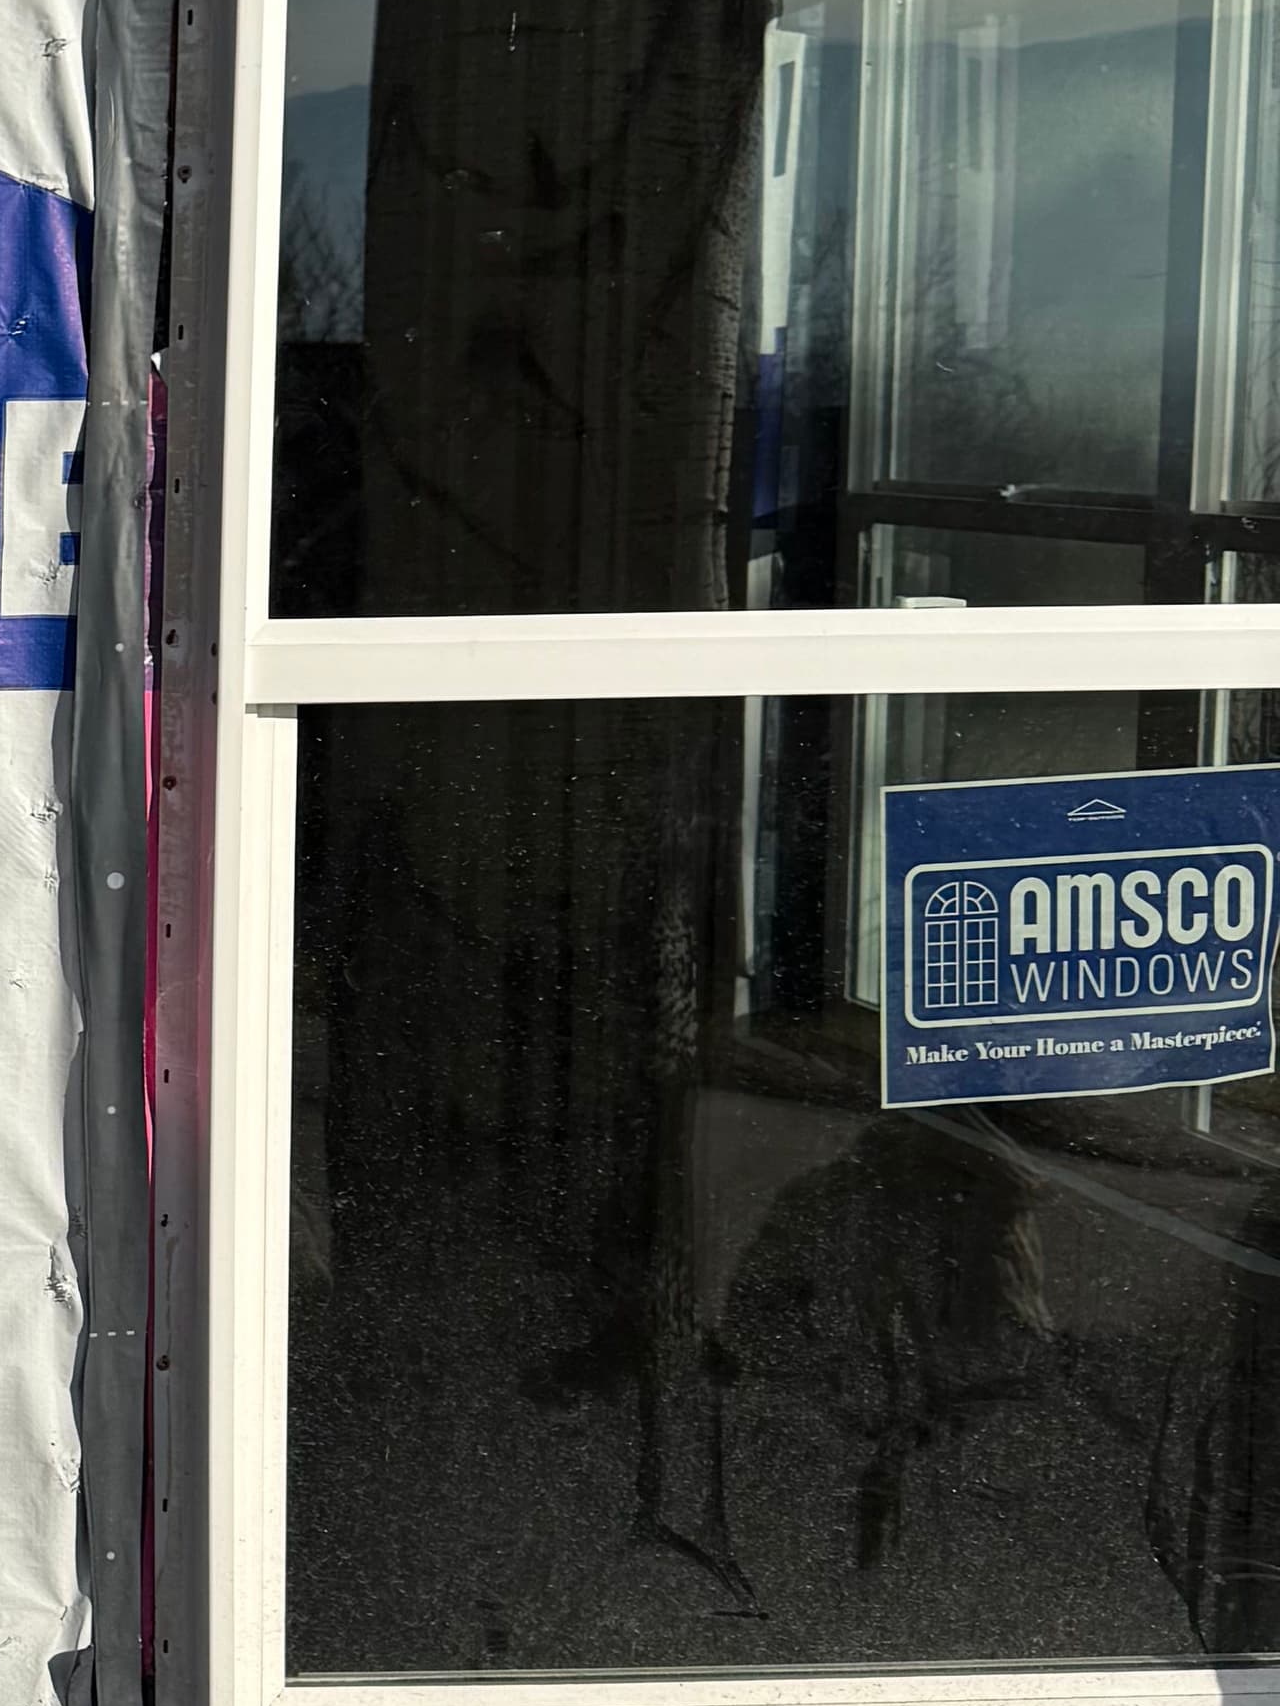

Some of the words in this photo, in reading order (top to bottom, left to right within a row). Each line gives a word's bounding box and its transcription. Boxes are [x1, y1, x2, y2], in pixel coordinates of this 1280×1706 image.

[1009, 864, 1255, 956] AMSCO
[1010, 949, 1254, 1004] WINDOWS
[905, 1046, 969, 1066] Make
[975, 1041, 1032, 1061] Your
[1036, 1038, 1105, 1057] Home
[1110, 1039, 1124, 1052] a
